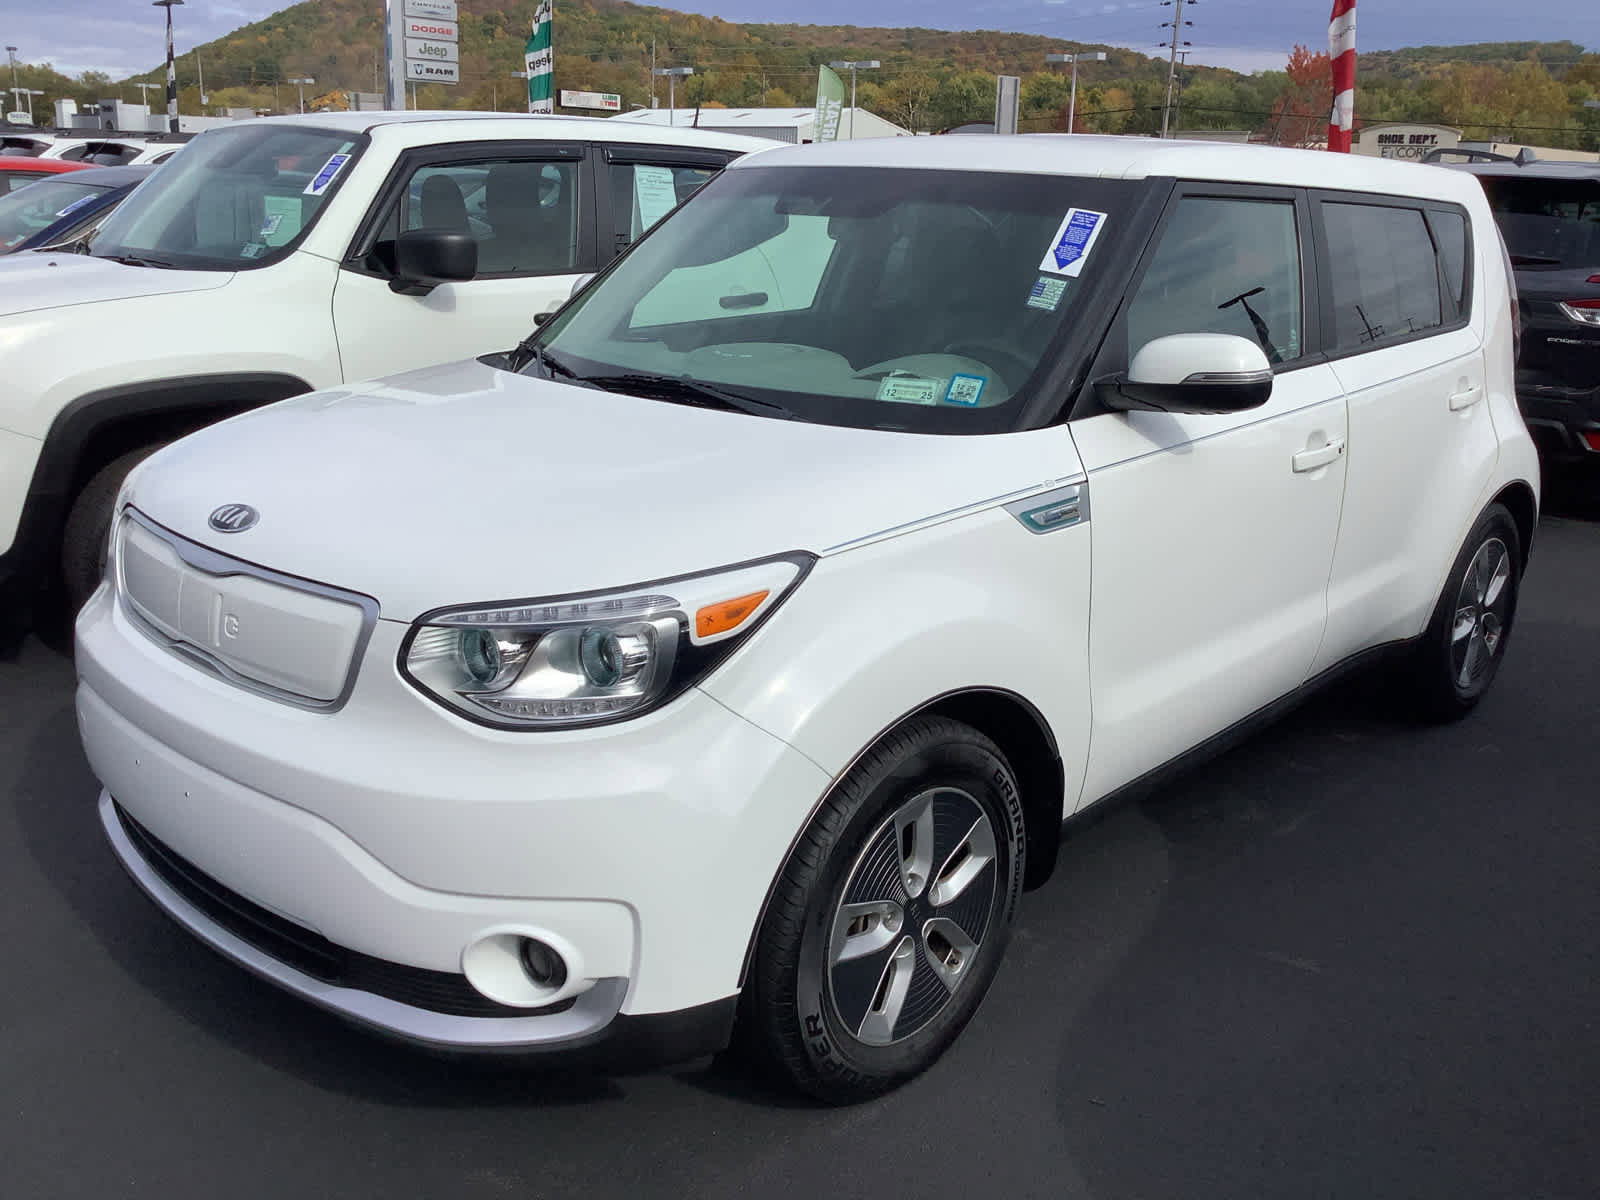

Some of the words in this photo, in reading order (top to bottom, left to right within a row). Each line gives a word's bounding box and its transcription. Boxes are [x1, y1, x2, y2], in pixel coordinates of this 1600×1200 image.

[411, 24, 453, 36] DODGE
[418, 42, 448, 59] Jeep
[425, 67, 454, 76] RAM
[1377, 134, 1405, 144] SHOE
[1408, 134, 1438, 144] DEPT.
[1381, 146, 1430, 158] ECOR
[885, 388, 897, 397] 12
[919, 391, 933, 400] 25
[211, 505, 250, 529] KIA
[994, 767, 1025, 857] GRAND
